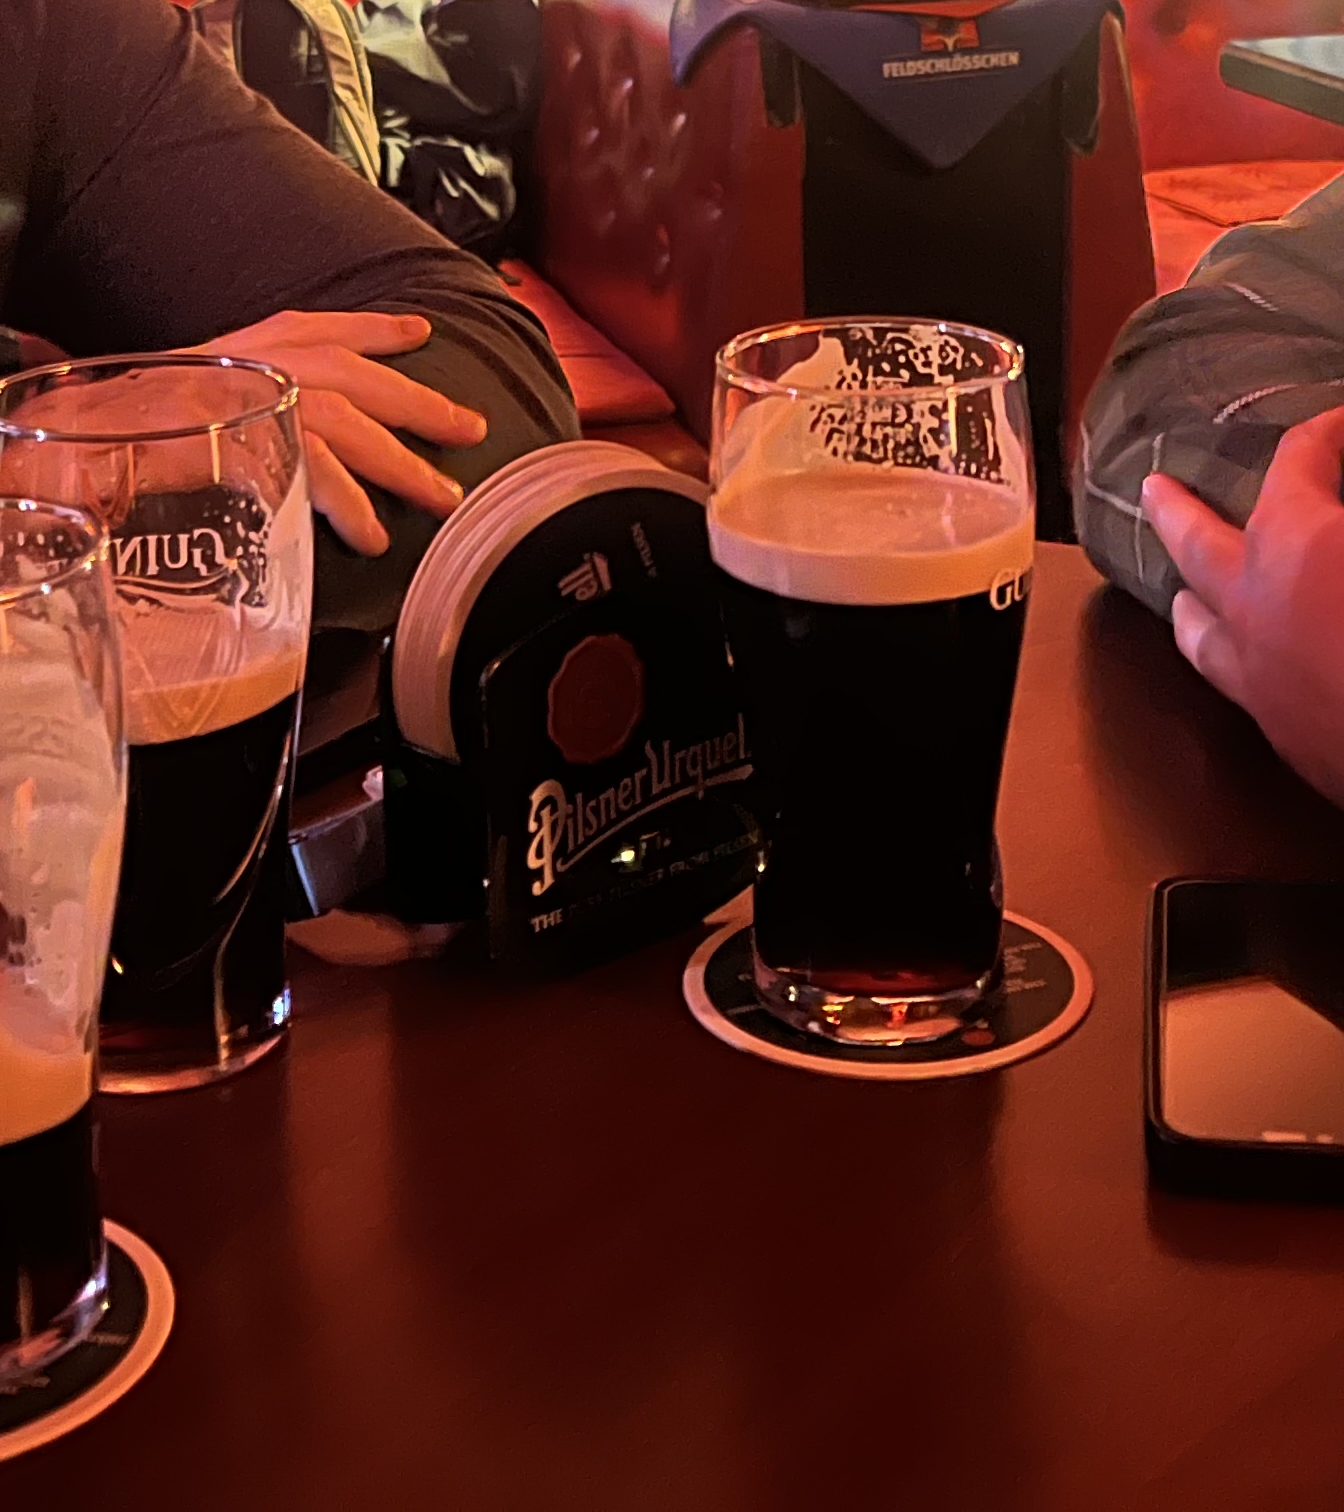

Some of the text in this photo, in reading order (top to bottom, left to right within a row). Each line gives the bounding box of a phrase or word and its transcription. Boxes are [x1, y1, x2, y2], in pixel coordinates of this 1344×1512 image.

[882, 51, 1020, 79] FELDSCHLÖSSCHEN
[527, 778, 648, 897] Pilsner
[530, 907, 564, 933] THE
